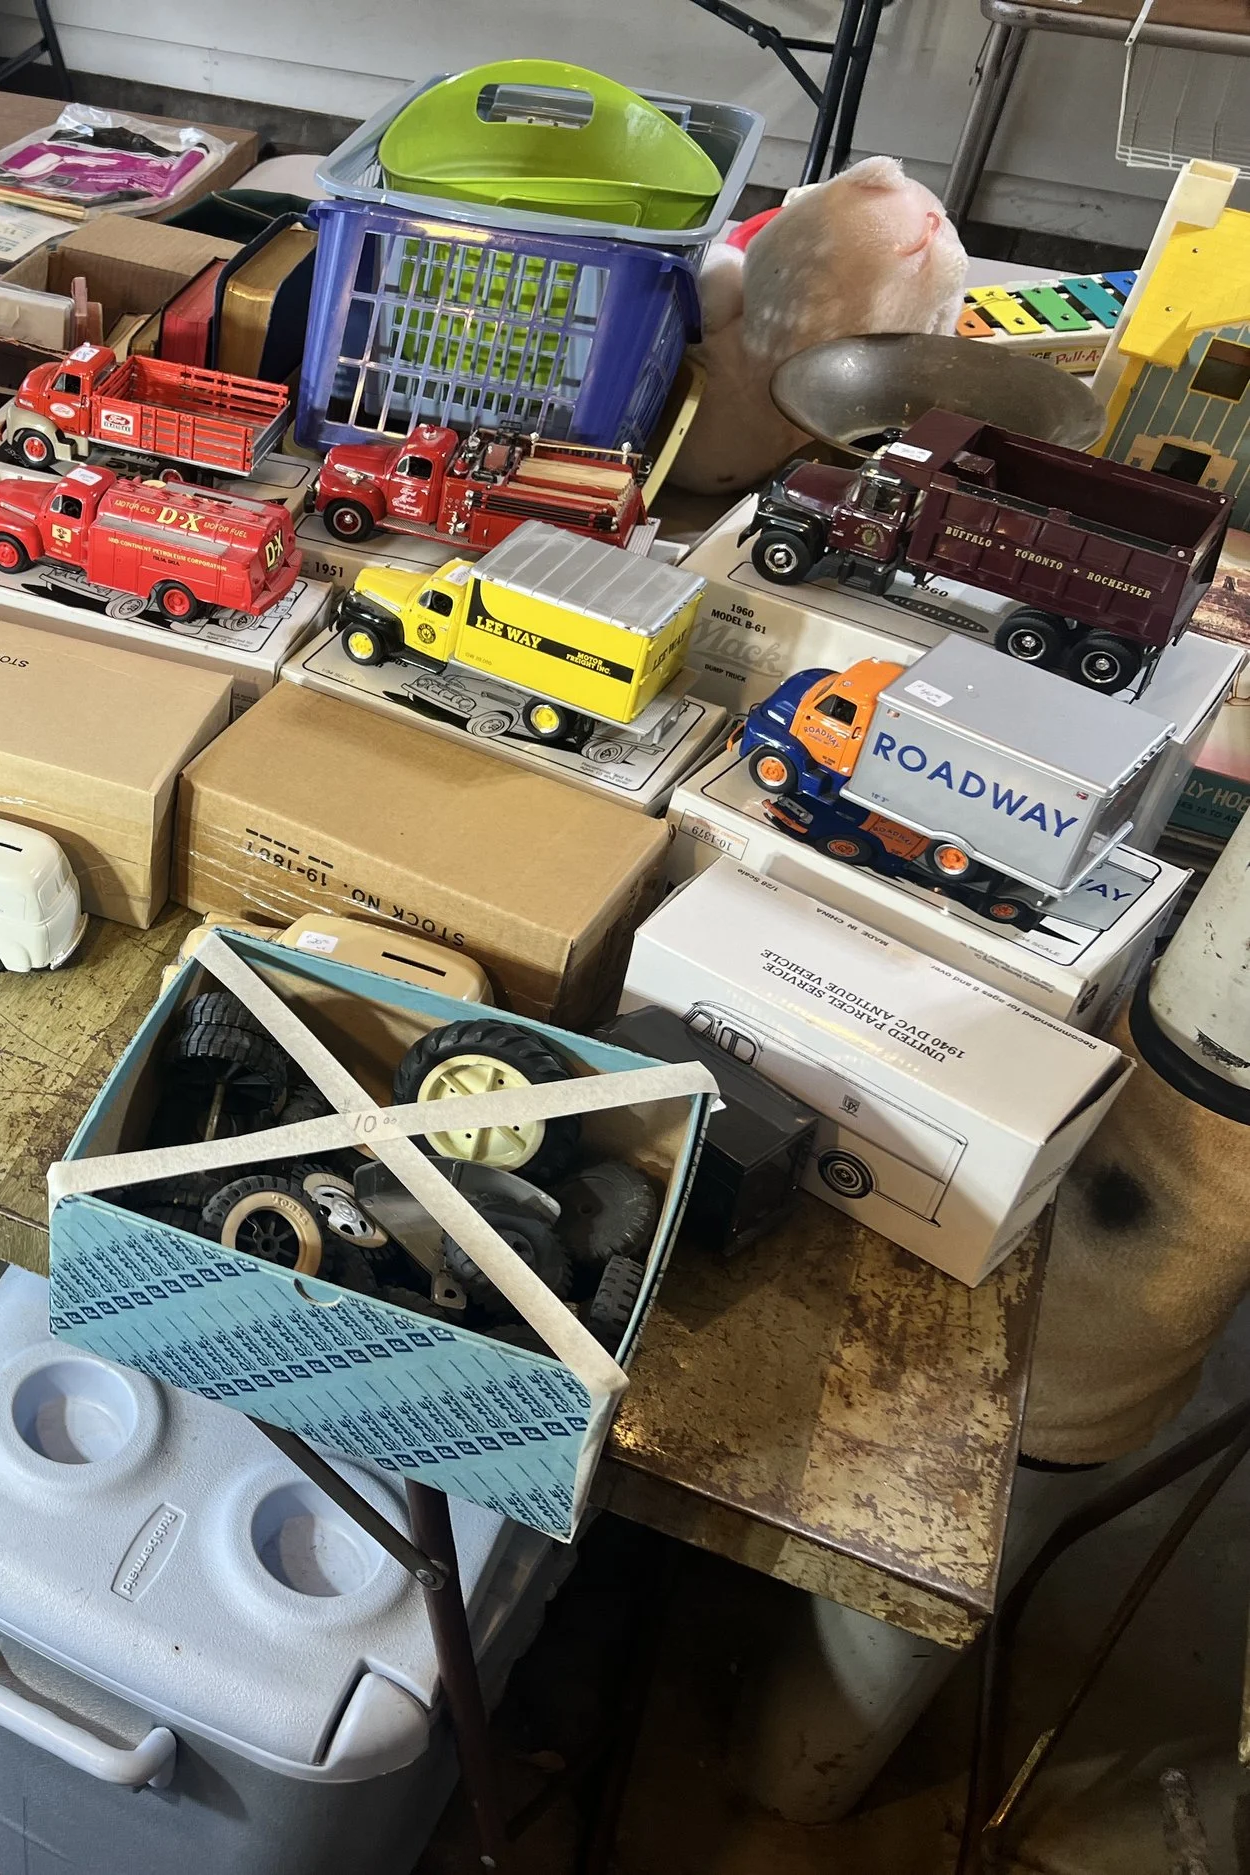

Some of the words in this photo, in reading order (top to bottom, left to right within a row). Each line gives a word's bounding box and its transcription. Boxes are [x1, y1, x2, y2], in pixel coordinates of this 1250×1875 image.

[114, 498, 139, 512] MOTOR
[140, 505, 157, 516] OILS
[203, 521, 228, 535] MOTOR
[229, 527, 248, 539] FUEL
[945, 527, 993, 548] BUFFALO
[152, 547, 186, 563] PETROLEUM
[186, 556, 228, 572] CORPORATION
[314, 561, 344, 578] 1951
[1014, 548, 1064, 571] TORONTO
[1086, 571, 1153, 600] ROCHESTER
[711, 608, 744, 628] MODEL
[745, 619, 767, 636] B-61
[730, 603, 756, 619] 1960
[475, 615, 504, 636] LEE
[506, 624, 543, 650] WAY
[565, 653, 597, 672] FREIGHT
[596, 663, 612, 676] INC.
[576, 651, 603, 667] MOTOR
[704, 663, 724, 677] DUMP
[724, 670, 747, 684] TRUCK
[802, 725, 841, 750] ROADWAY
[871, 731, 1079, 838] ROADWAY
[691, 824, 732, 851] 10-1379
[737, 868, 762, 884] Scale
[764, 881, 779, 893] 1/28
[392, 904, 465, 948] STOCK
[815, 907, 845, 925] CHINA
[847, 922, 859, 931] IN
[861, 930, 889, 947] MADE
[759, 947, 824, 989] VEHICLE
[762, 961, 826, 999] SERVICE
[952, 975, 972, 987] and
[825, 983, 895, 1023] ANTIQUE
[981, 989, 1006, 1004] ages
[1005, 1002, 1022, 1013] for
[828, 994, 886, 1031] PARCEL
[896, 1018, 930, 1042] DVC
[1021, 1009, 1098, 1050] Recommended
[888, 1028, 947, 1064] UNITED
[929, 1034, 967, 1060] 1940
[270, 1193, 311, 1226] Tonka
[120, 1510, 179, 1596] Rubbermaid
